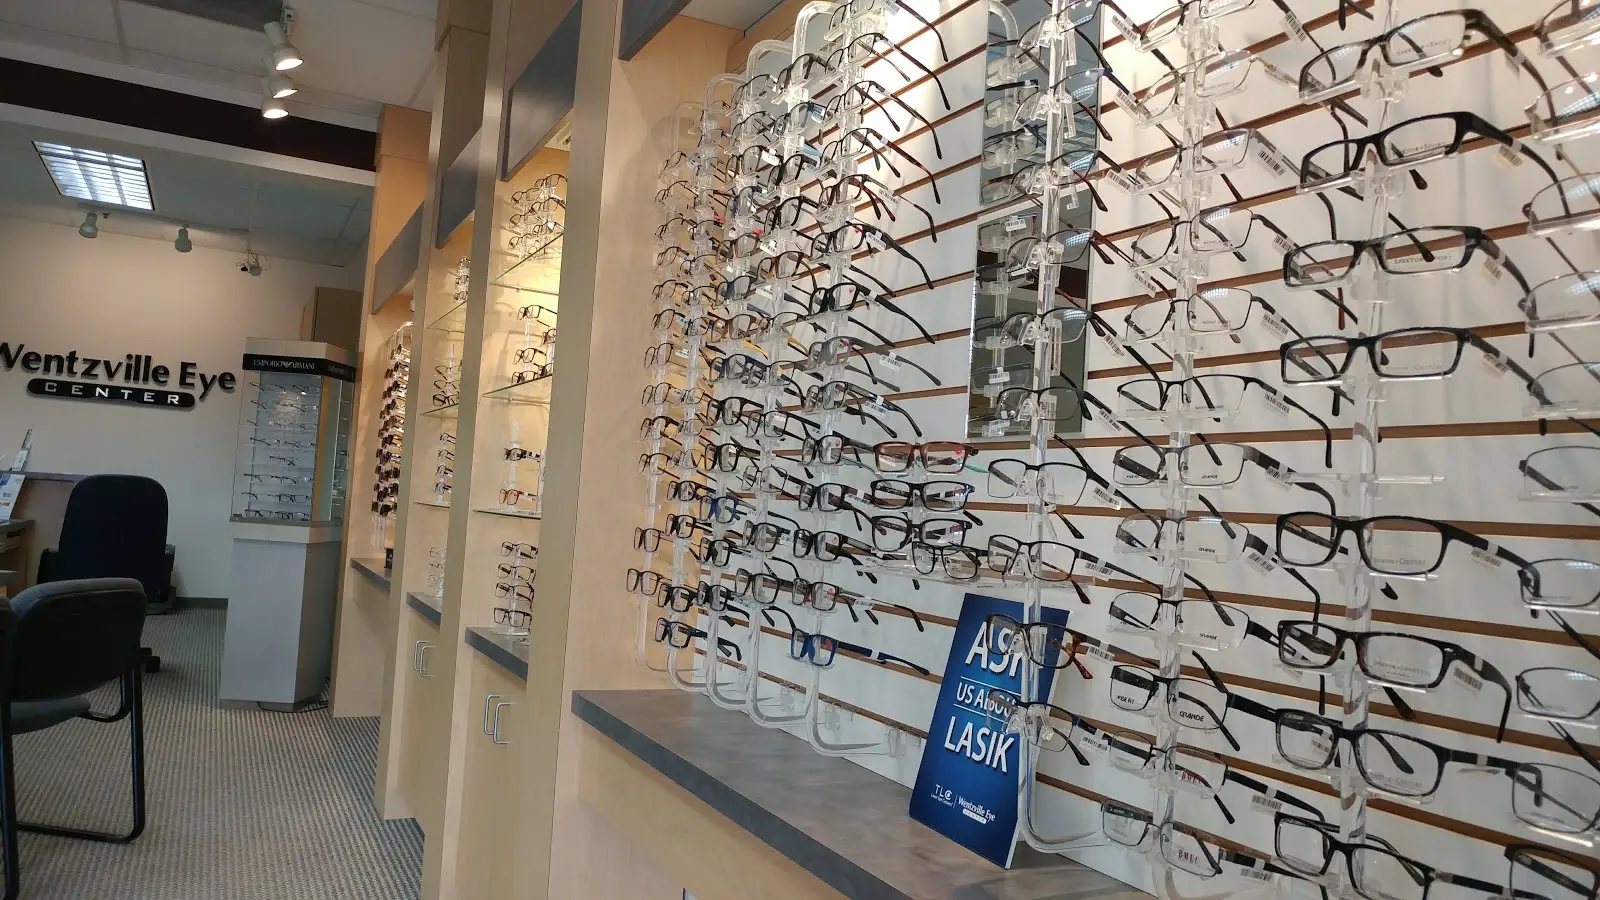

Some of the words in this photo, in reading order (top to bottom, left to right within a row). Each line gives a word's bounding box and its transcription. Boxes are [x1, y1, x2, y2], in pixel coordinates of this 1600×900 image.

[0, 342, 170, 385] Wentzville
[179, 361, 236, 401] Eye
[253, 359, 284, 368] EMPORIO
[290, 361, 315, 370] ARMANI
[44, 382, 180, 405] CENTER
[956, 682, 975, 704] US
[974, 688, 1017, 717] ABOU
[1179, 710, 1205, 722] GRANDE
[944, 715, 1015, 773] LASIK
[935, 784, 952, 800] TLC
[958, 796, 986, 816] Wentzville
[985, 809, 996, 823] Eye
